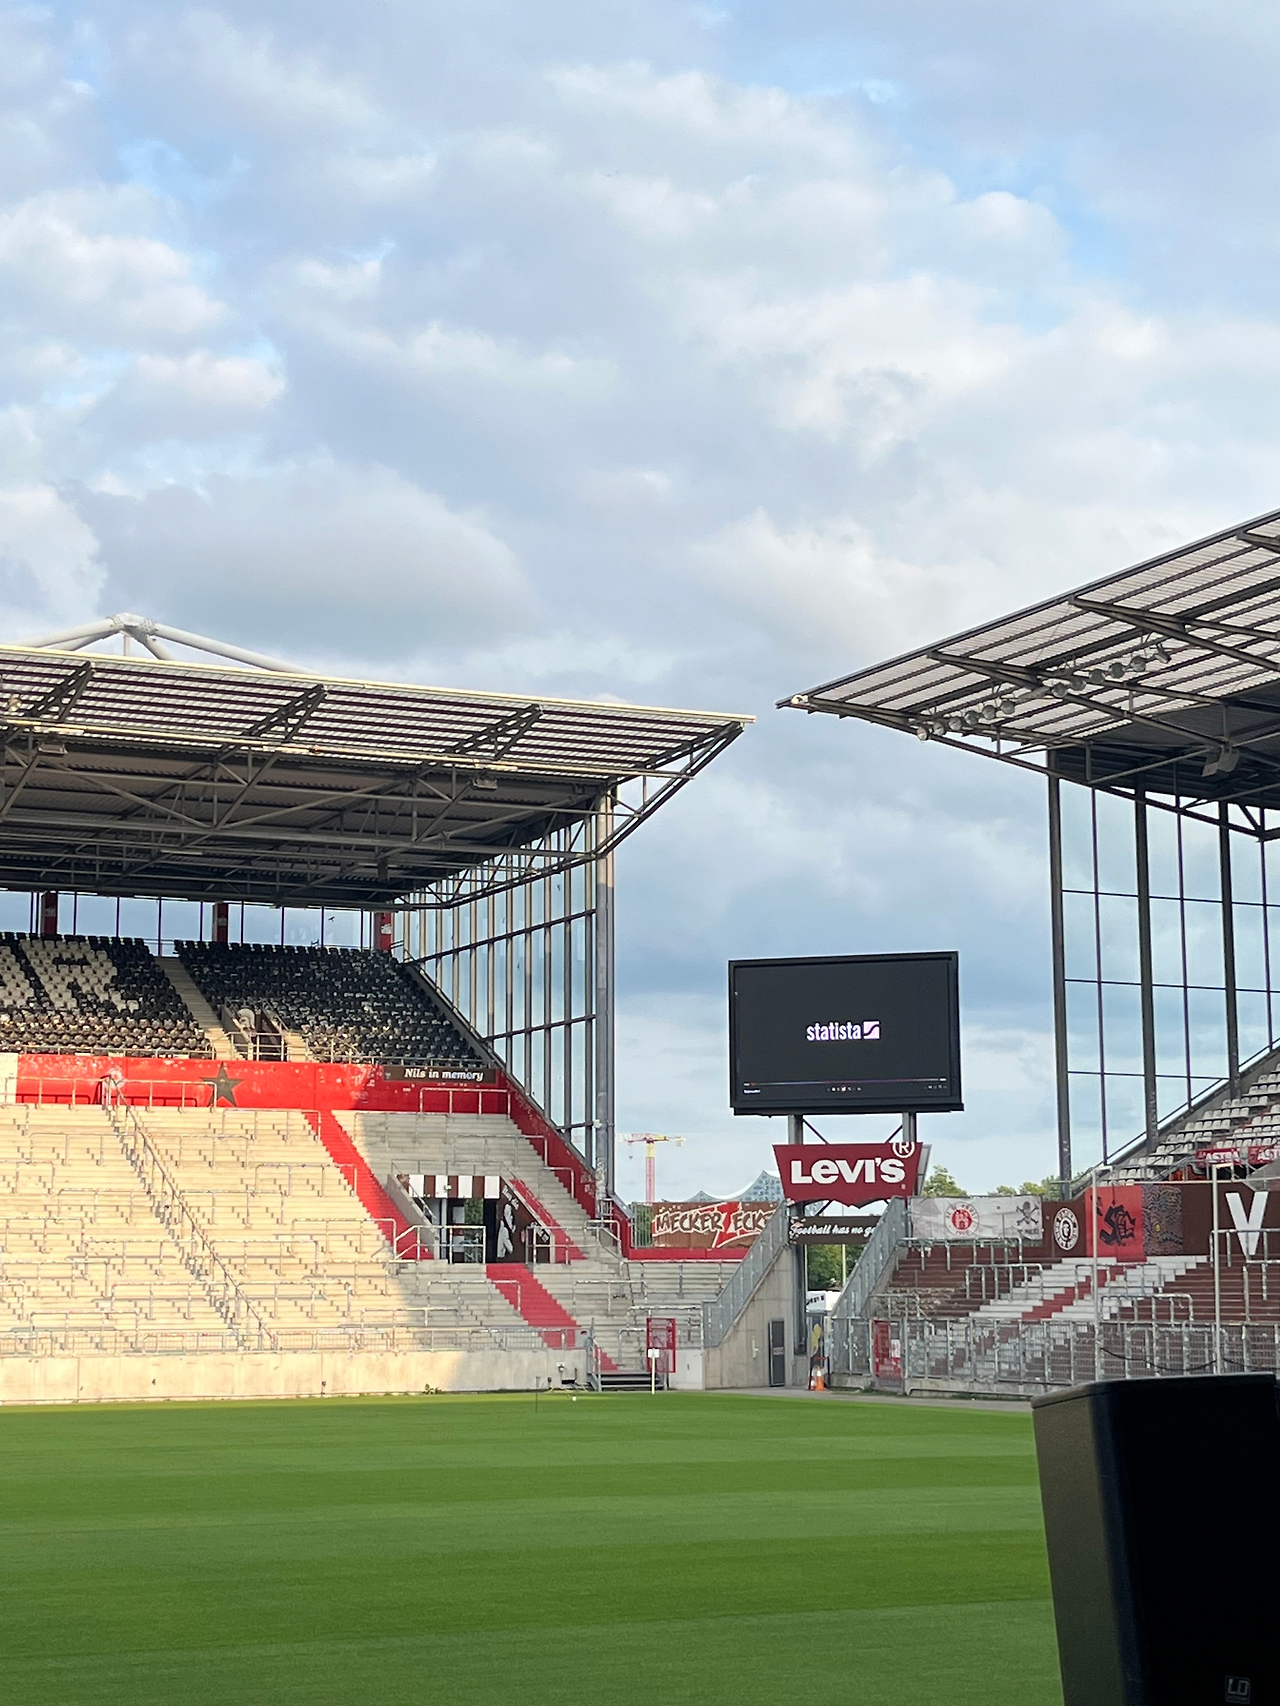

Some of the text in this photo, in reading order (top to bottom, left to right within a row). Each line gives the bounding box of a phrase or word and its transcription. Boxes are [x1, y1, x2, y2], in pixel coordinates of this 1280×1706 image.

[806, 1021, 861, 1041] statista
[404, 1068, 484, 1081] Nils in memory
[656, 1211, 724, 1231] MECKER
[832, 1225, 849, 1234] has
[1227, 1679, 1249, 1696] LD
